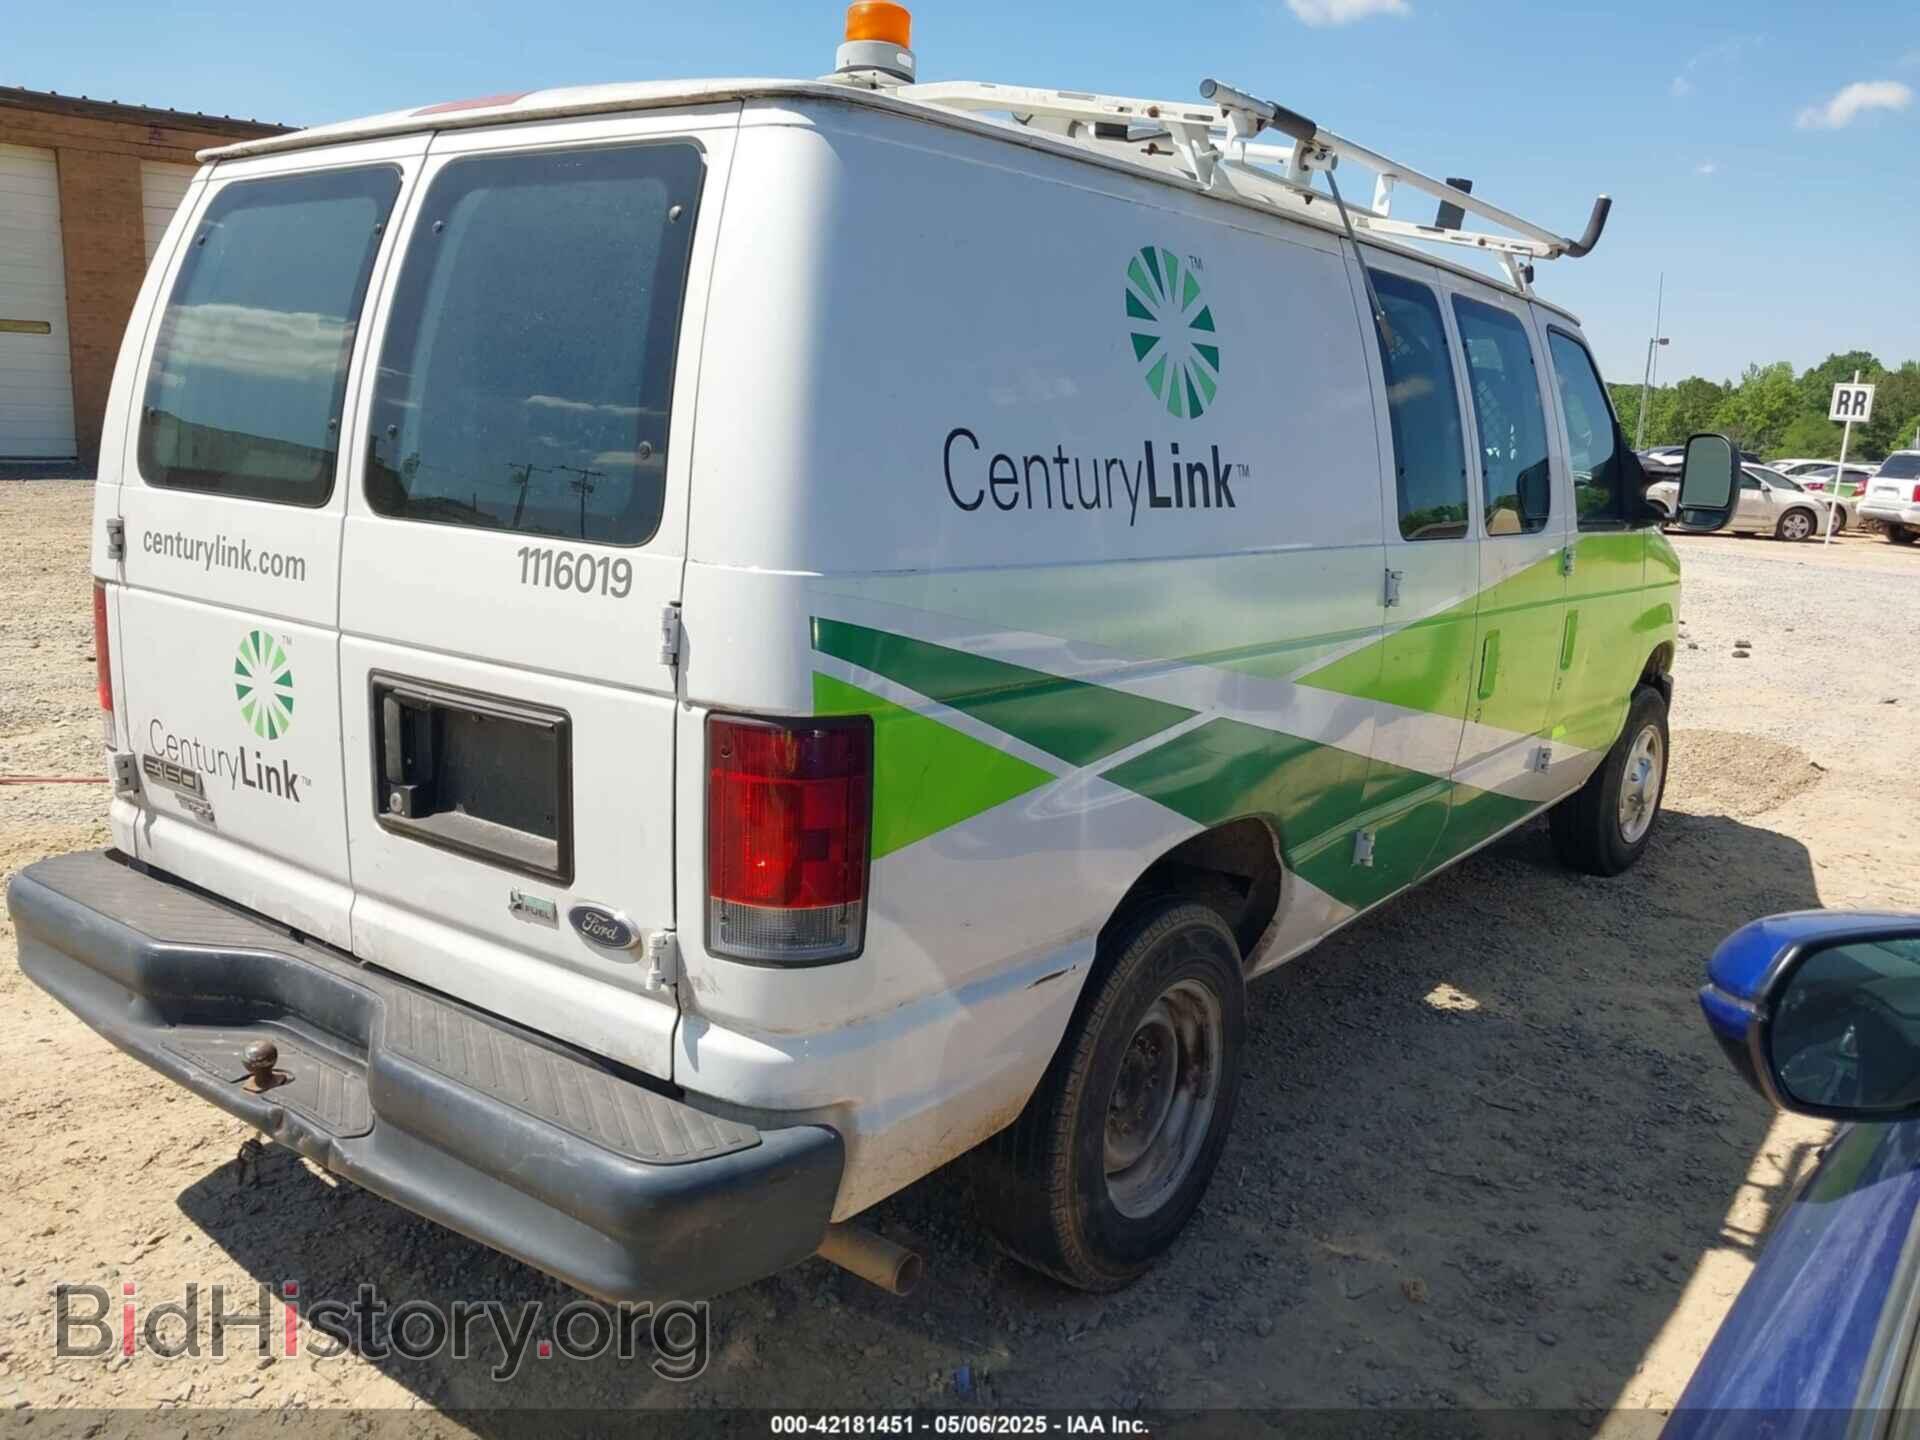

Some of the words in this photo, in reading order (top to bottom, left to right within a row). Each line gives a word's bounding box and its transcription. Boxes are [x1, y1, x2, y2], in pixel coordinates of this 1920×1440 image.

[1836, 390, 1867, 416] RR
[943, 427, 1236, 526] CenturyLink
[143, 528, 306, 582] centurylink.com
[517, 546, 633, 599] 1116019
[149, 718, 300, 803] CenturyLink
[581, 911, 618, 940] Ford
